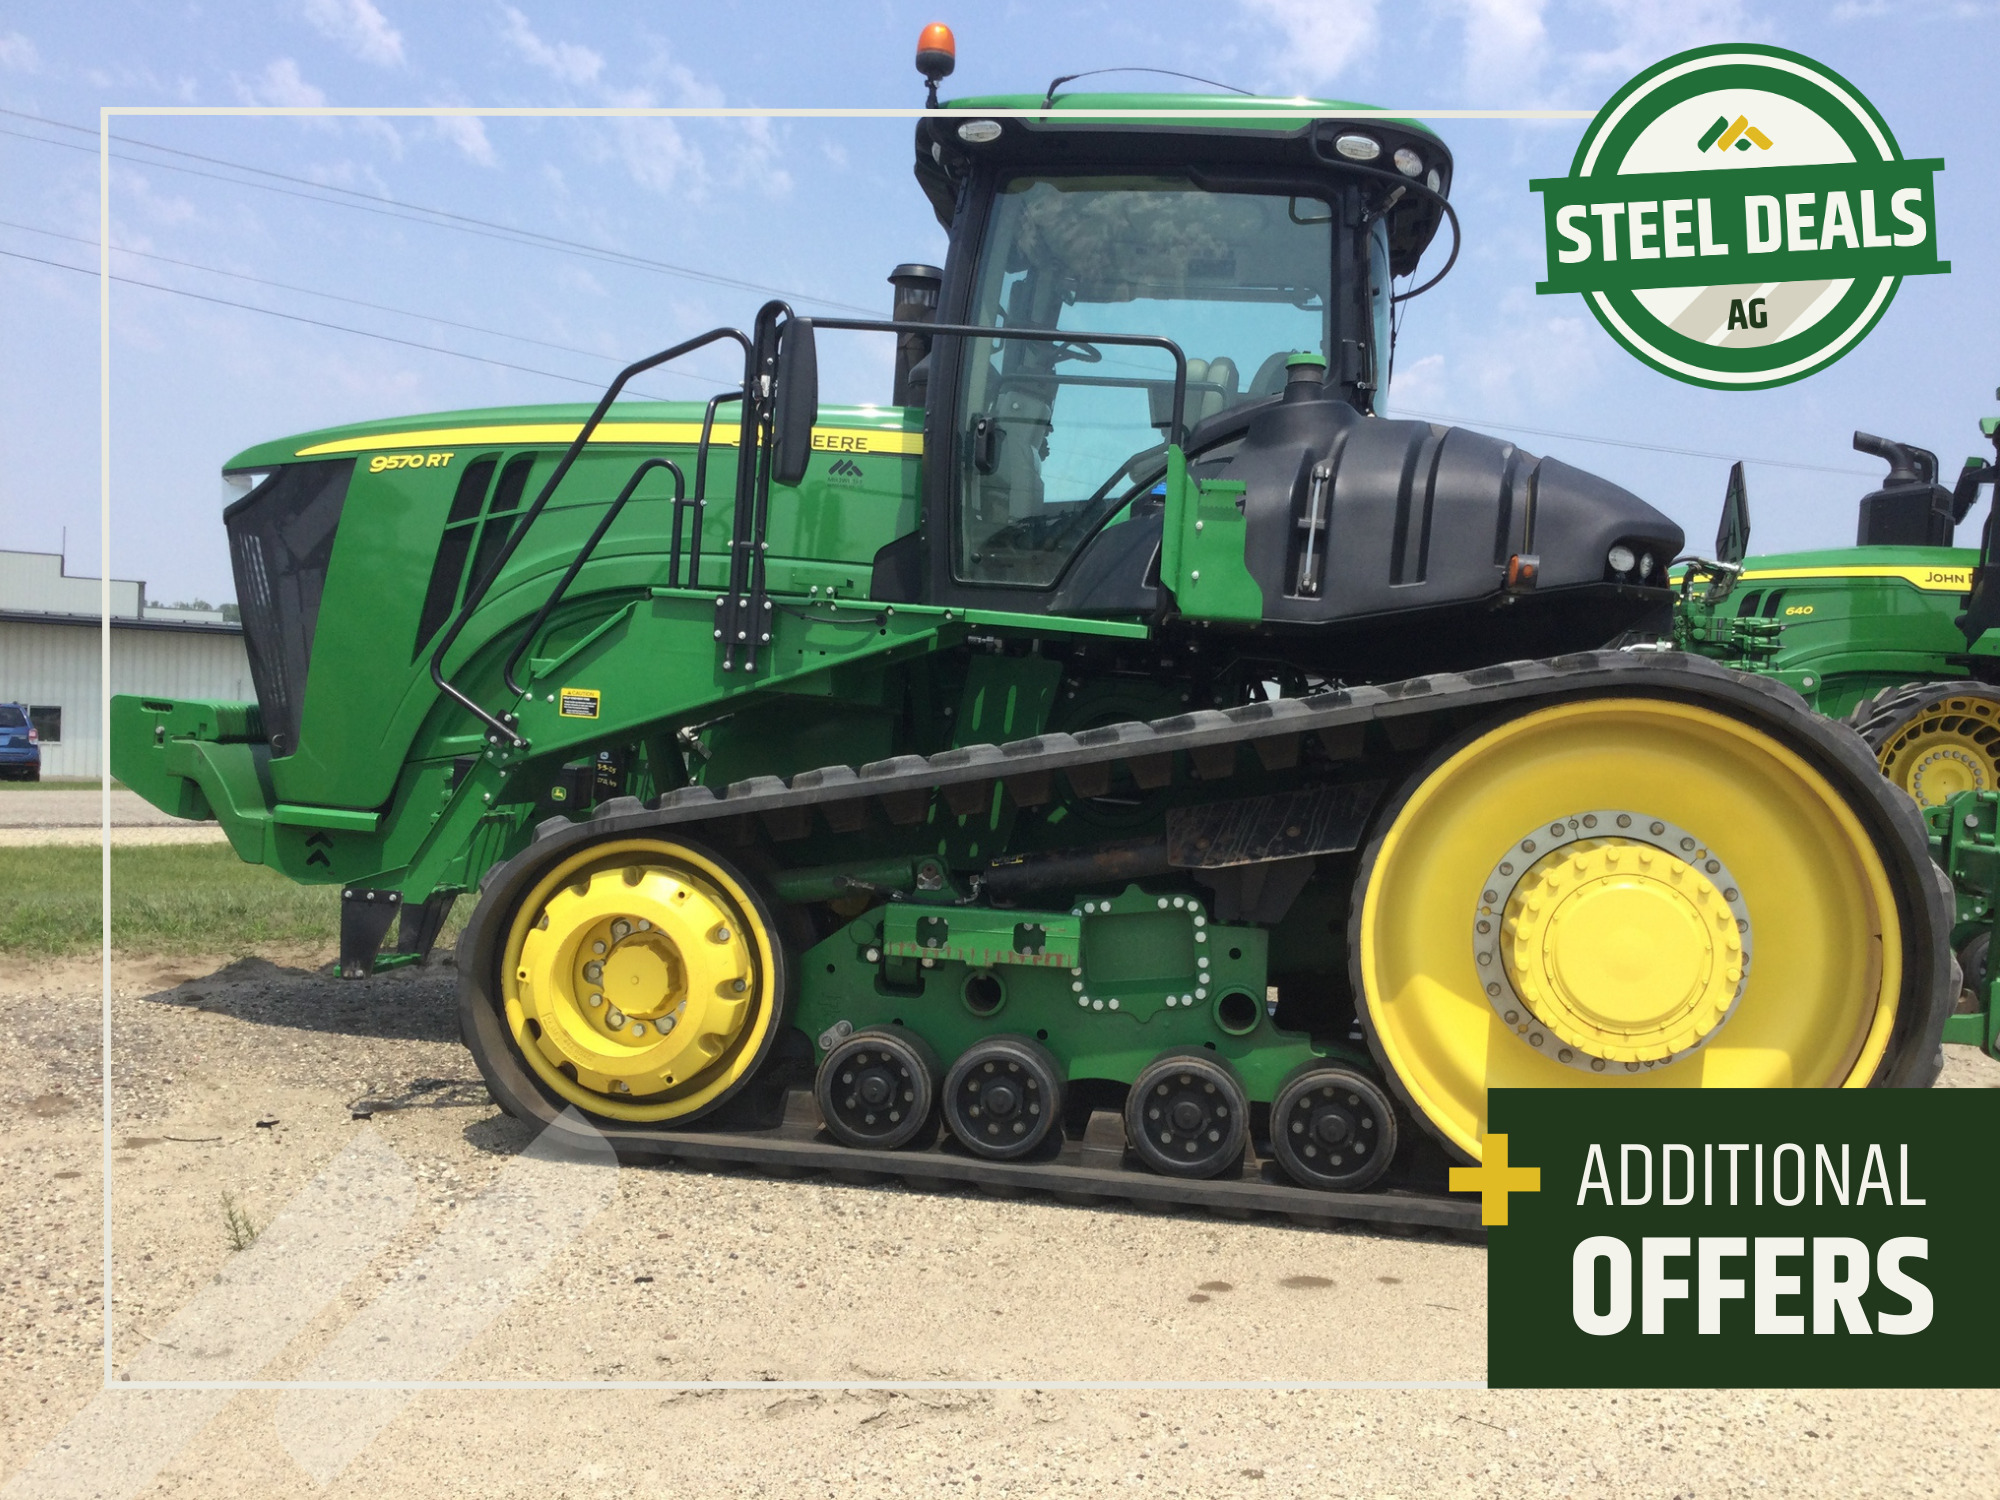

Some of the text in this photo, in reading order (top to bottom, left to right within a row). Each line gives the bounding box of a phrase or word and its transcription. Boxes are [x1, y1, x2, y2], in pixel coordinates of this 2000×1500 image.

[812, 434, 868, 450] EERE
[1925, 572, 1964, 583] JOHN
[1785, 605, 1814, 616] 640
